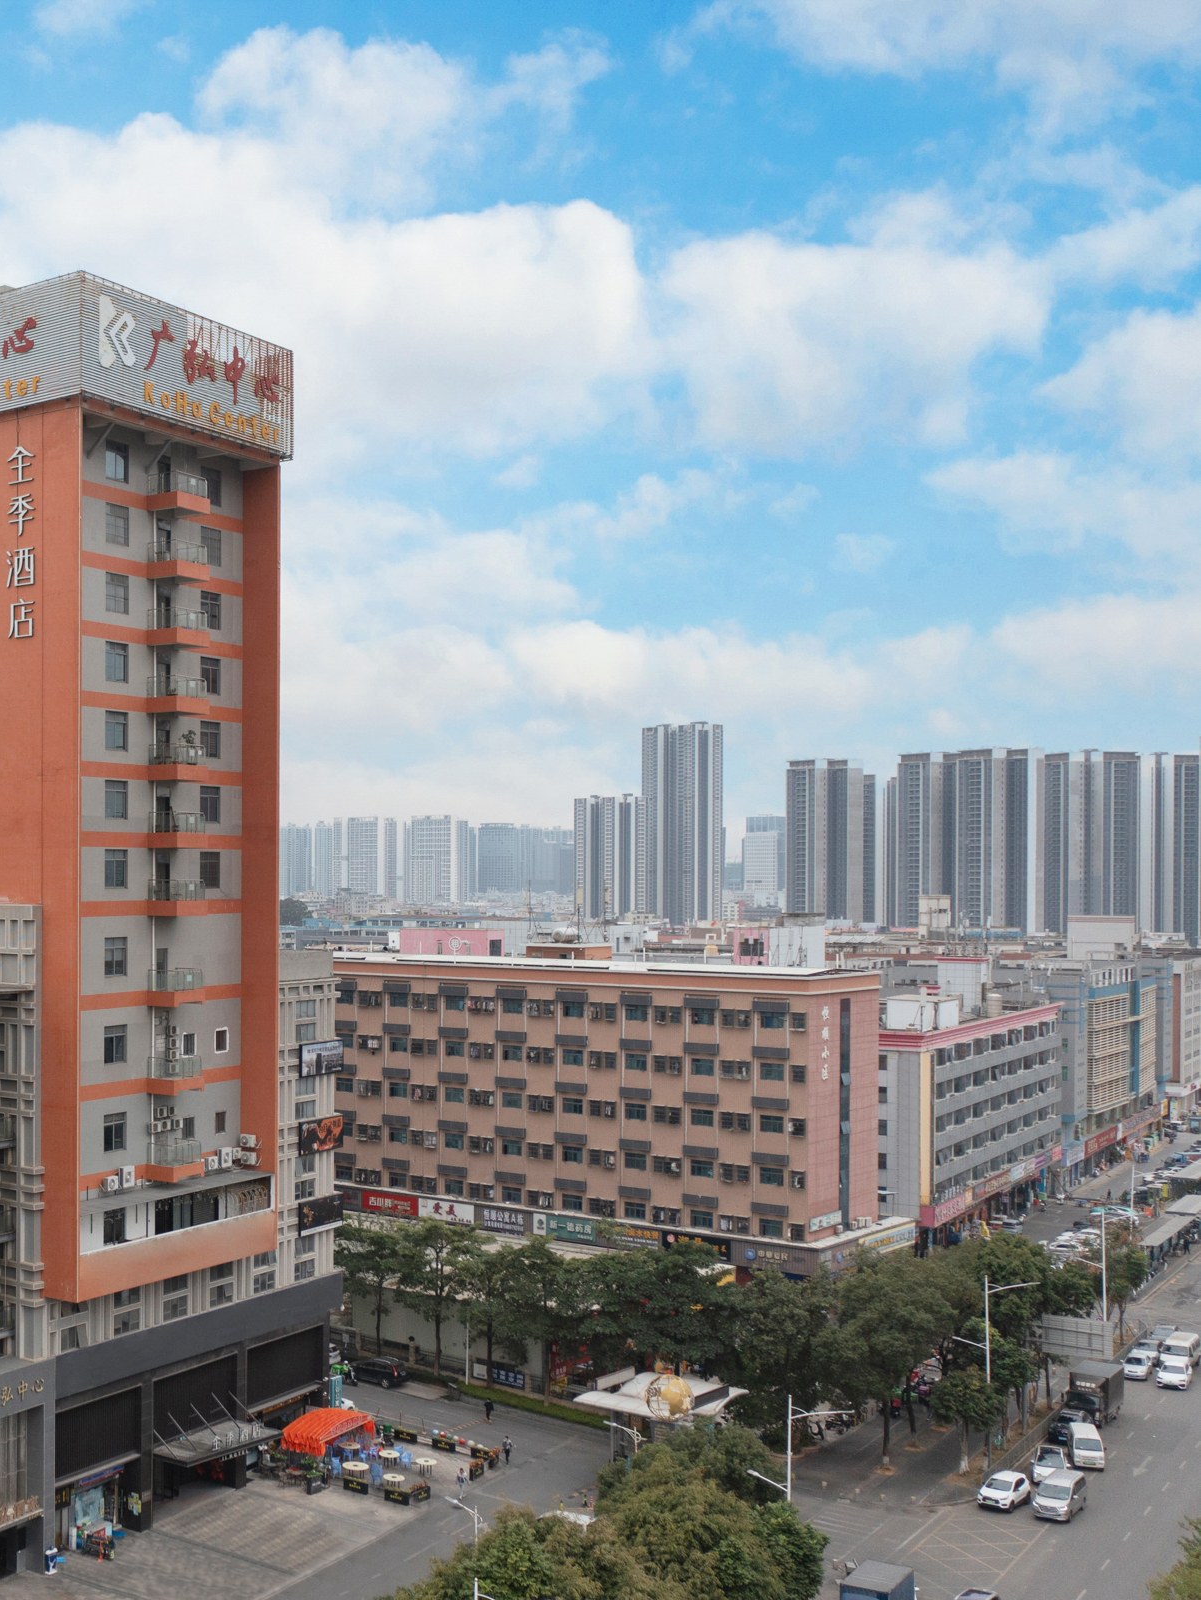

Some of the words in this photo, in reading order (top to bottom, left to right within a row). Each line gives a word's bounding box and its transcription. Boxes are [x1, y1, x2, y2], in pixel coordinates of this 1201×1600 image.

[144, 319, 282, 405] 广弘中心
[143, 380, 202, 419] KoHo
[209, 401, 281, 443] Center
[6, 445, 35, 639] 全季酒店
[549, 1219, 593, 1235] 新一德药房
[212, 1423, 261, 1452] 全季酒店
